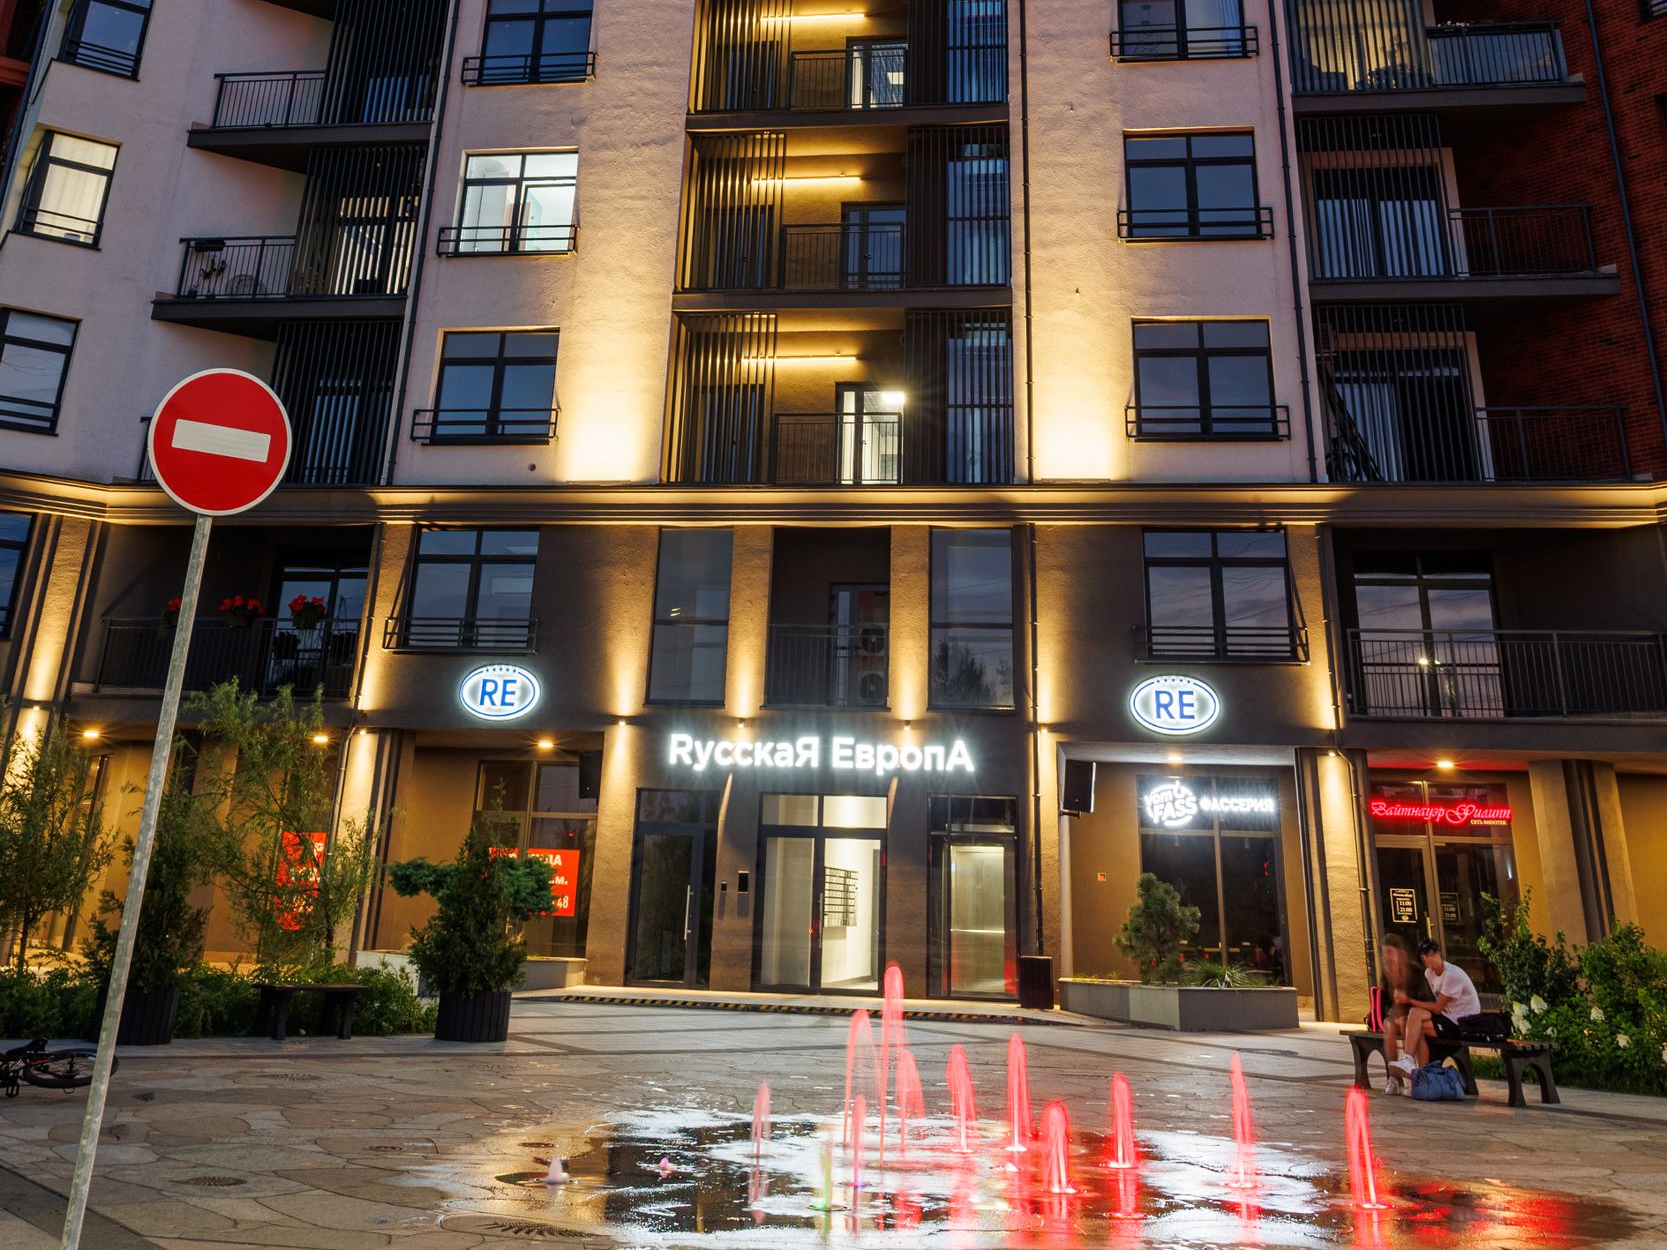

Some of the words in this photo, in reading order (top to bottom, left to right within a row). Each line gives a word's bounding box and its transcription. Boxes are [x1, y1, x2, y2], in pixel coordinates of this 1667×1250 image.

[479, 678, 517, 706] RE
[1155, 690, 1195, 719] RE
[1153, 796, 1198, 823] FASS
[1199, 796, 1276, 812] ФАССЕРИЯ
[1371, 802, 1444, 822] Вайтнауэр
